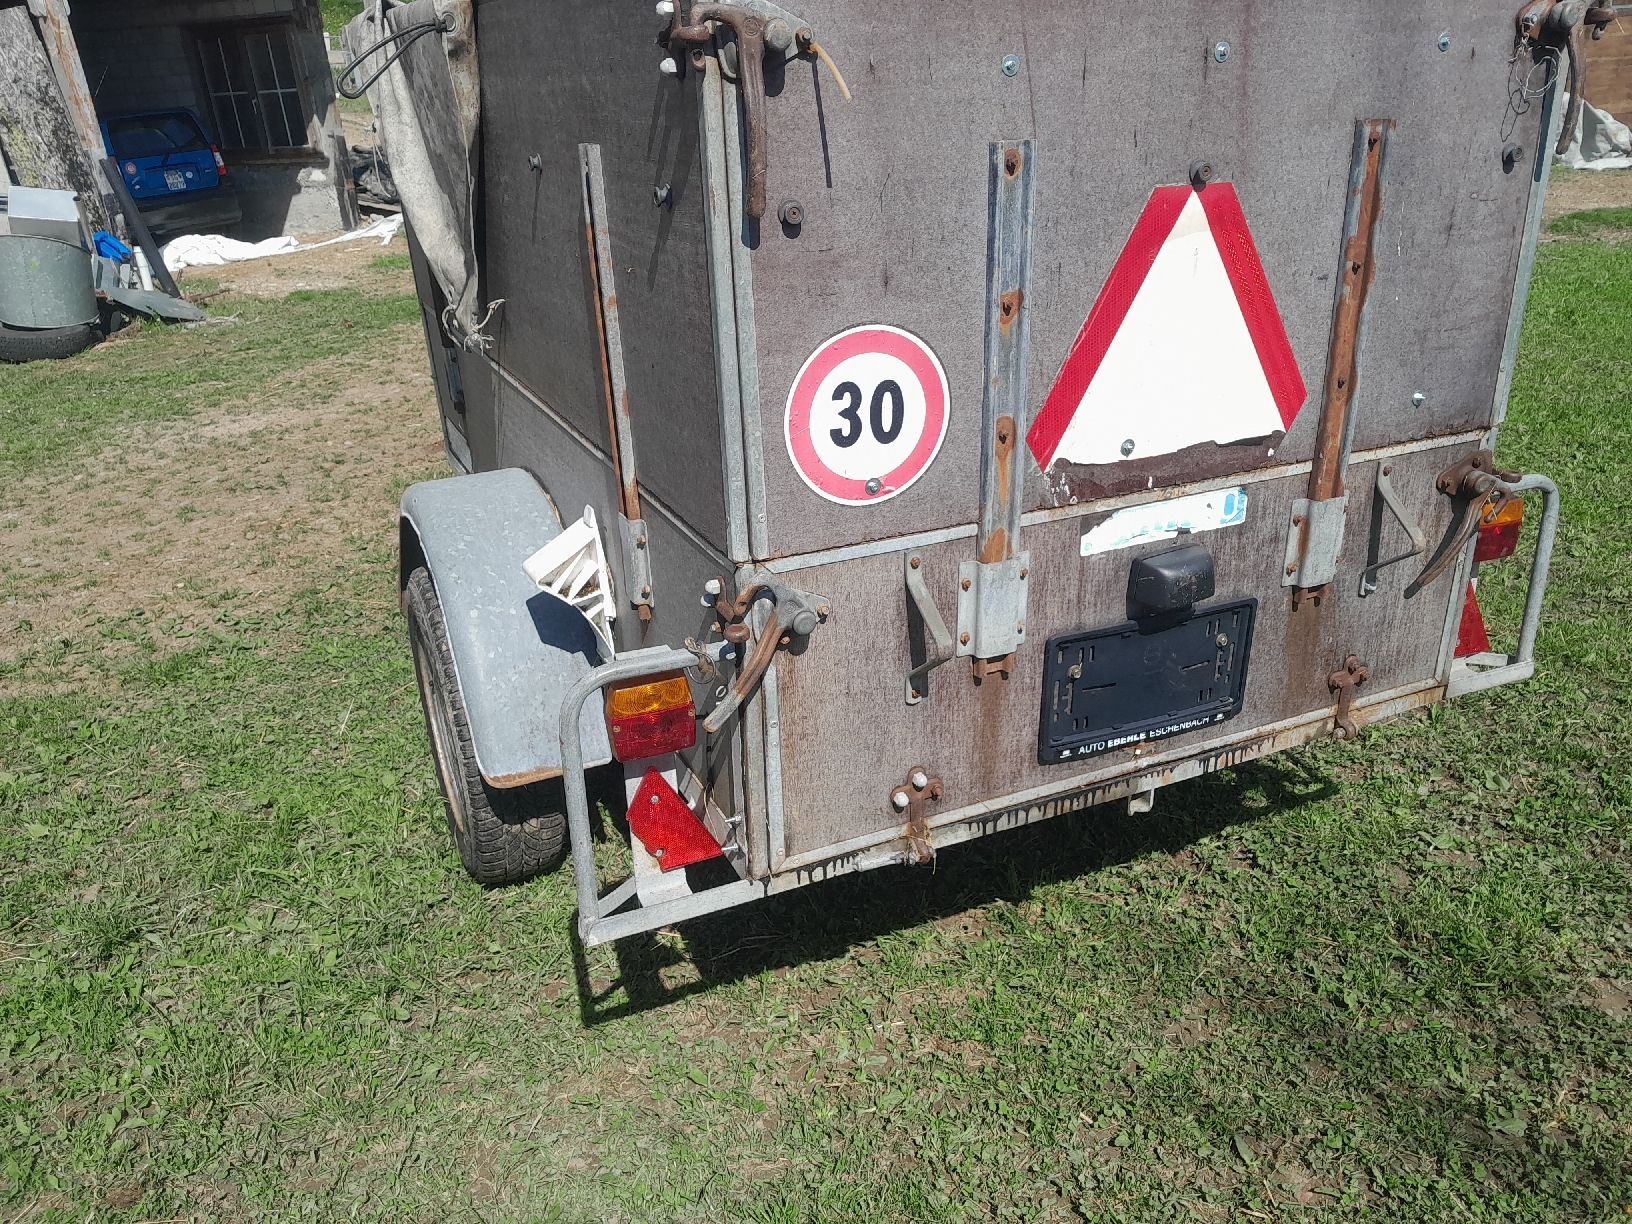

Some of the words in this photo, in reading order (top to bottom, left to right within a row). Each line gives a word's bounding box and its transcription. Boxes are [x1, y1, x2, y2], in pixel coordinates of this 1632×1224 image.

[829, 379, 904, 448] 30
[1078, 741, 1105, 755] AUTO
[1107, 732, 1147, 748] EBERLE
[1149, 716, 1210, 738] ESCHENBACH
